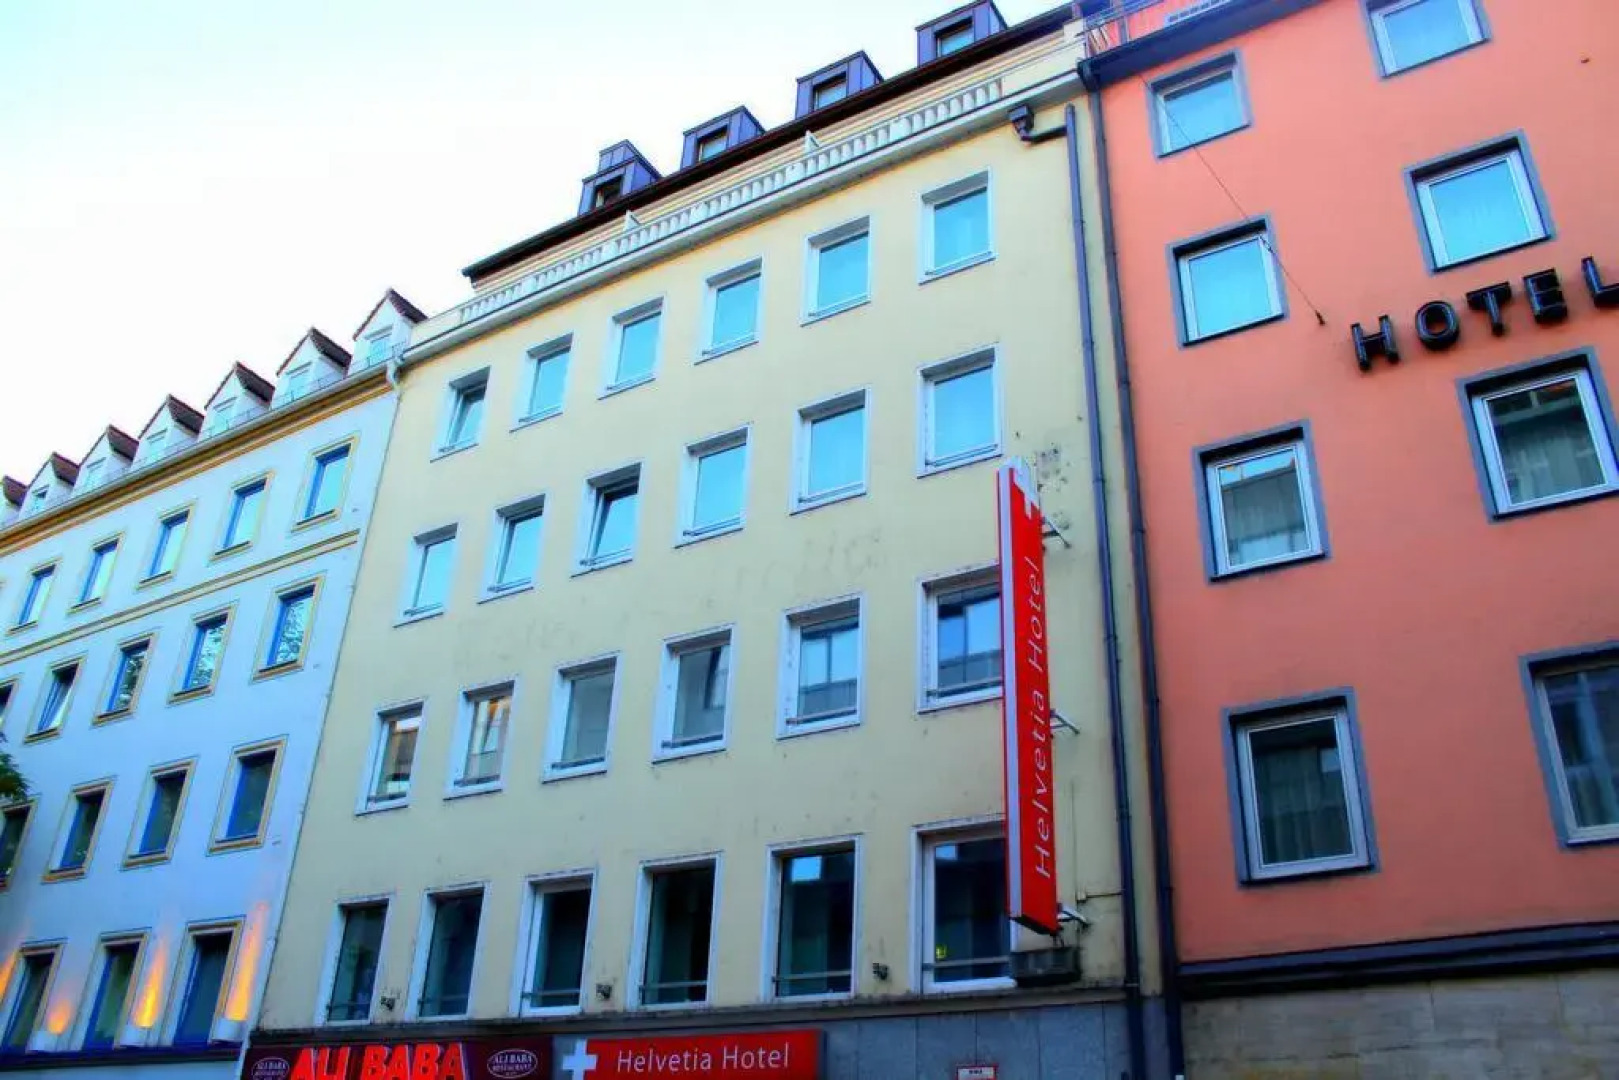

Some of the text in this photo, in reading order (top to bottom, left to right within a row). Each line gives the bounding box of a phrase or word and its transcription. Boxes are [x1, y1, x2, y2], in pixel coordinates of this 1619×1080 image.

[1350, 255, 1619, 372] HOTEL
[1024, 556, 1051, 877] Helvetia Hotel
[289, 1043, 467, 1080] ALI BABA
[617, 1041, 789, 1073] Helvetia Hotel
